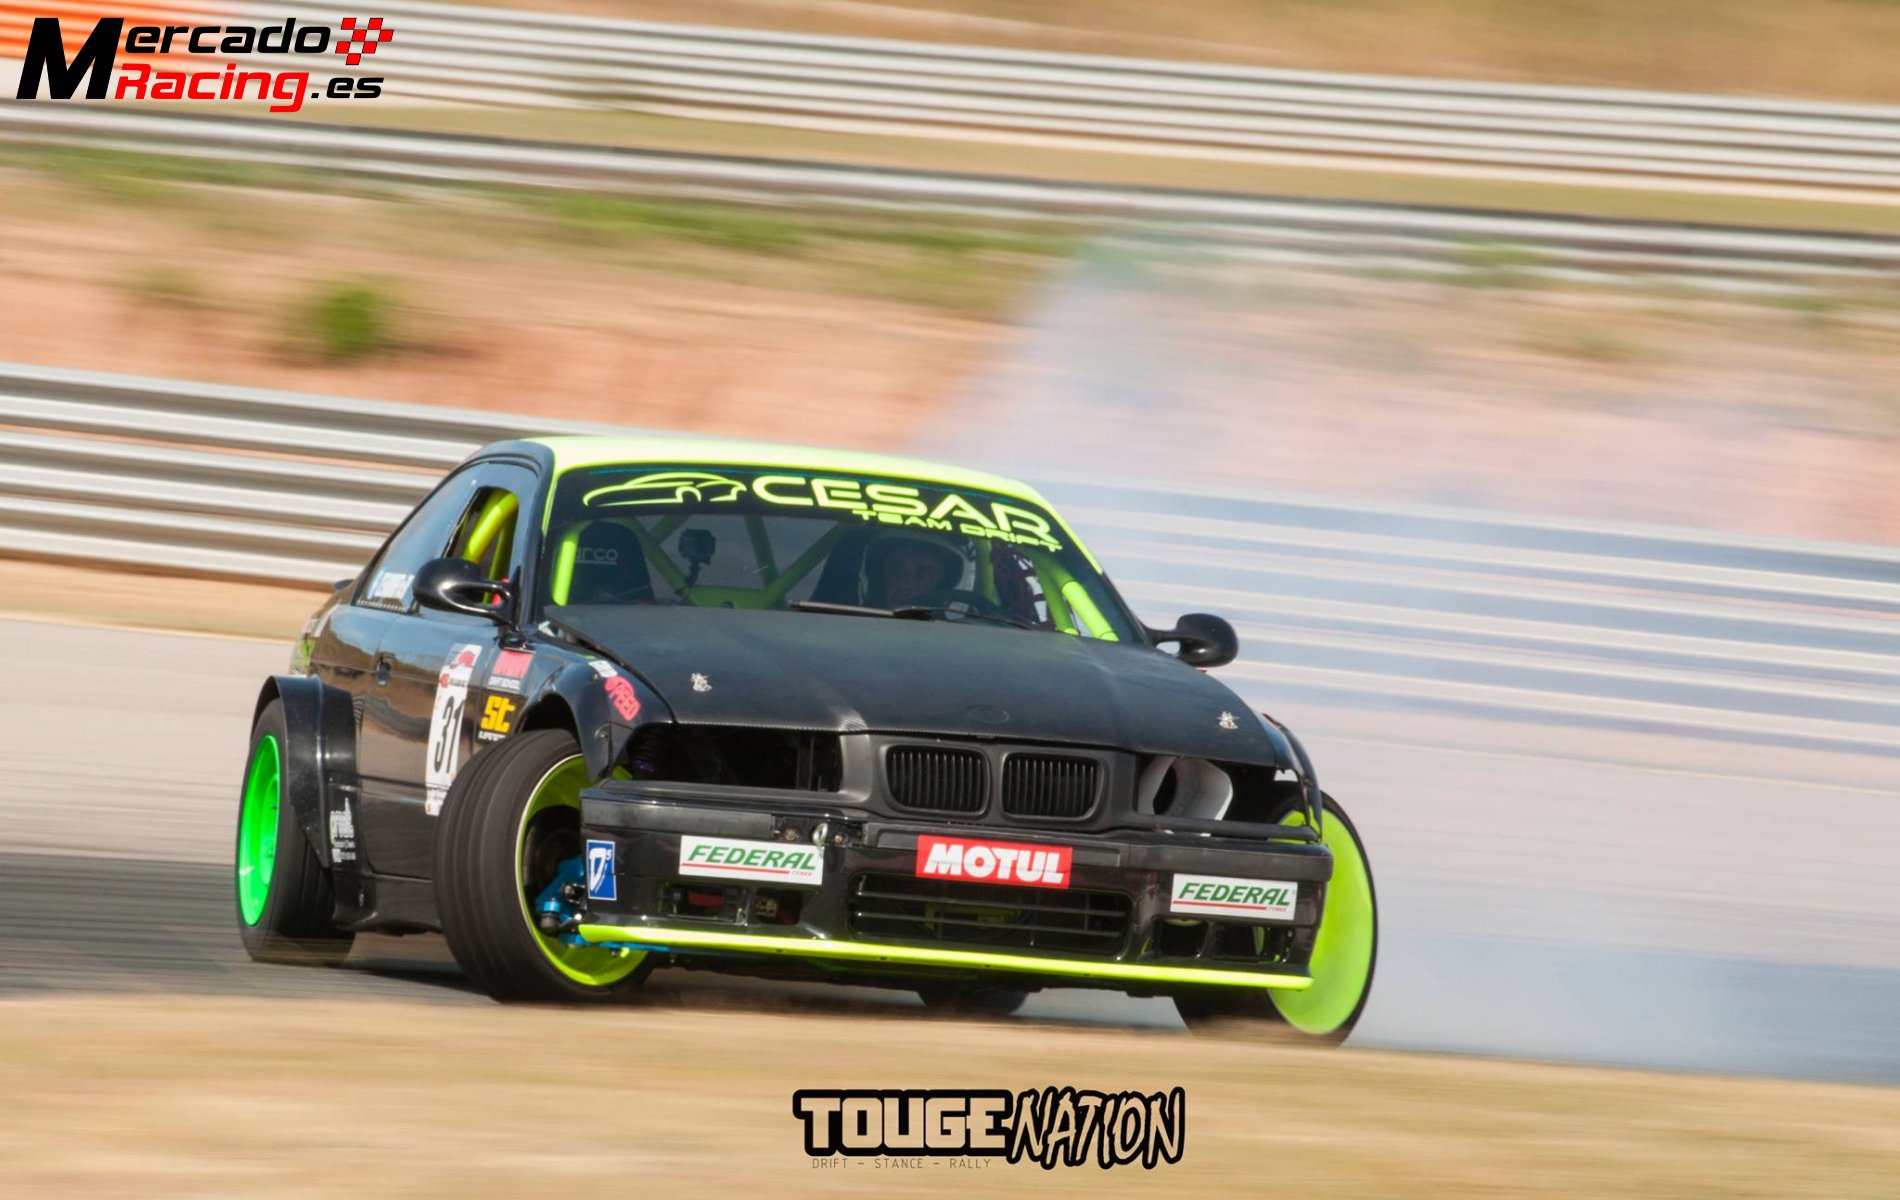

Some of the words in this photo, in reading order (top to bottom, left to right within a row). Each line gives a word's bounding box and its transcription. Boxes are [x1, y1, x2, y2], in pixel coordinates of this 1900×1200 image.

[752, 475, 1061, 545] CESAR
[852, 509, 952, 531] TEAM
[960, 523, 1063, 552] DRIFT
[434, 695, 465, 774] 31
[687, 844, 816, 871] FEDERAL
[923, 842, 1065, 885] MOTUL
[1178, 882, 1291, 906] FEDERAL
